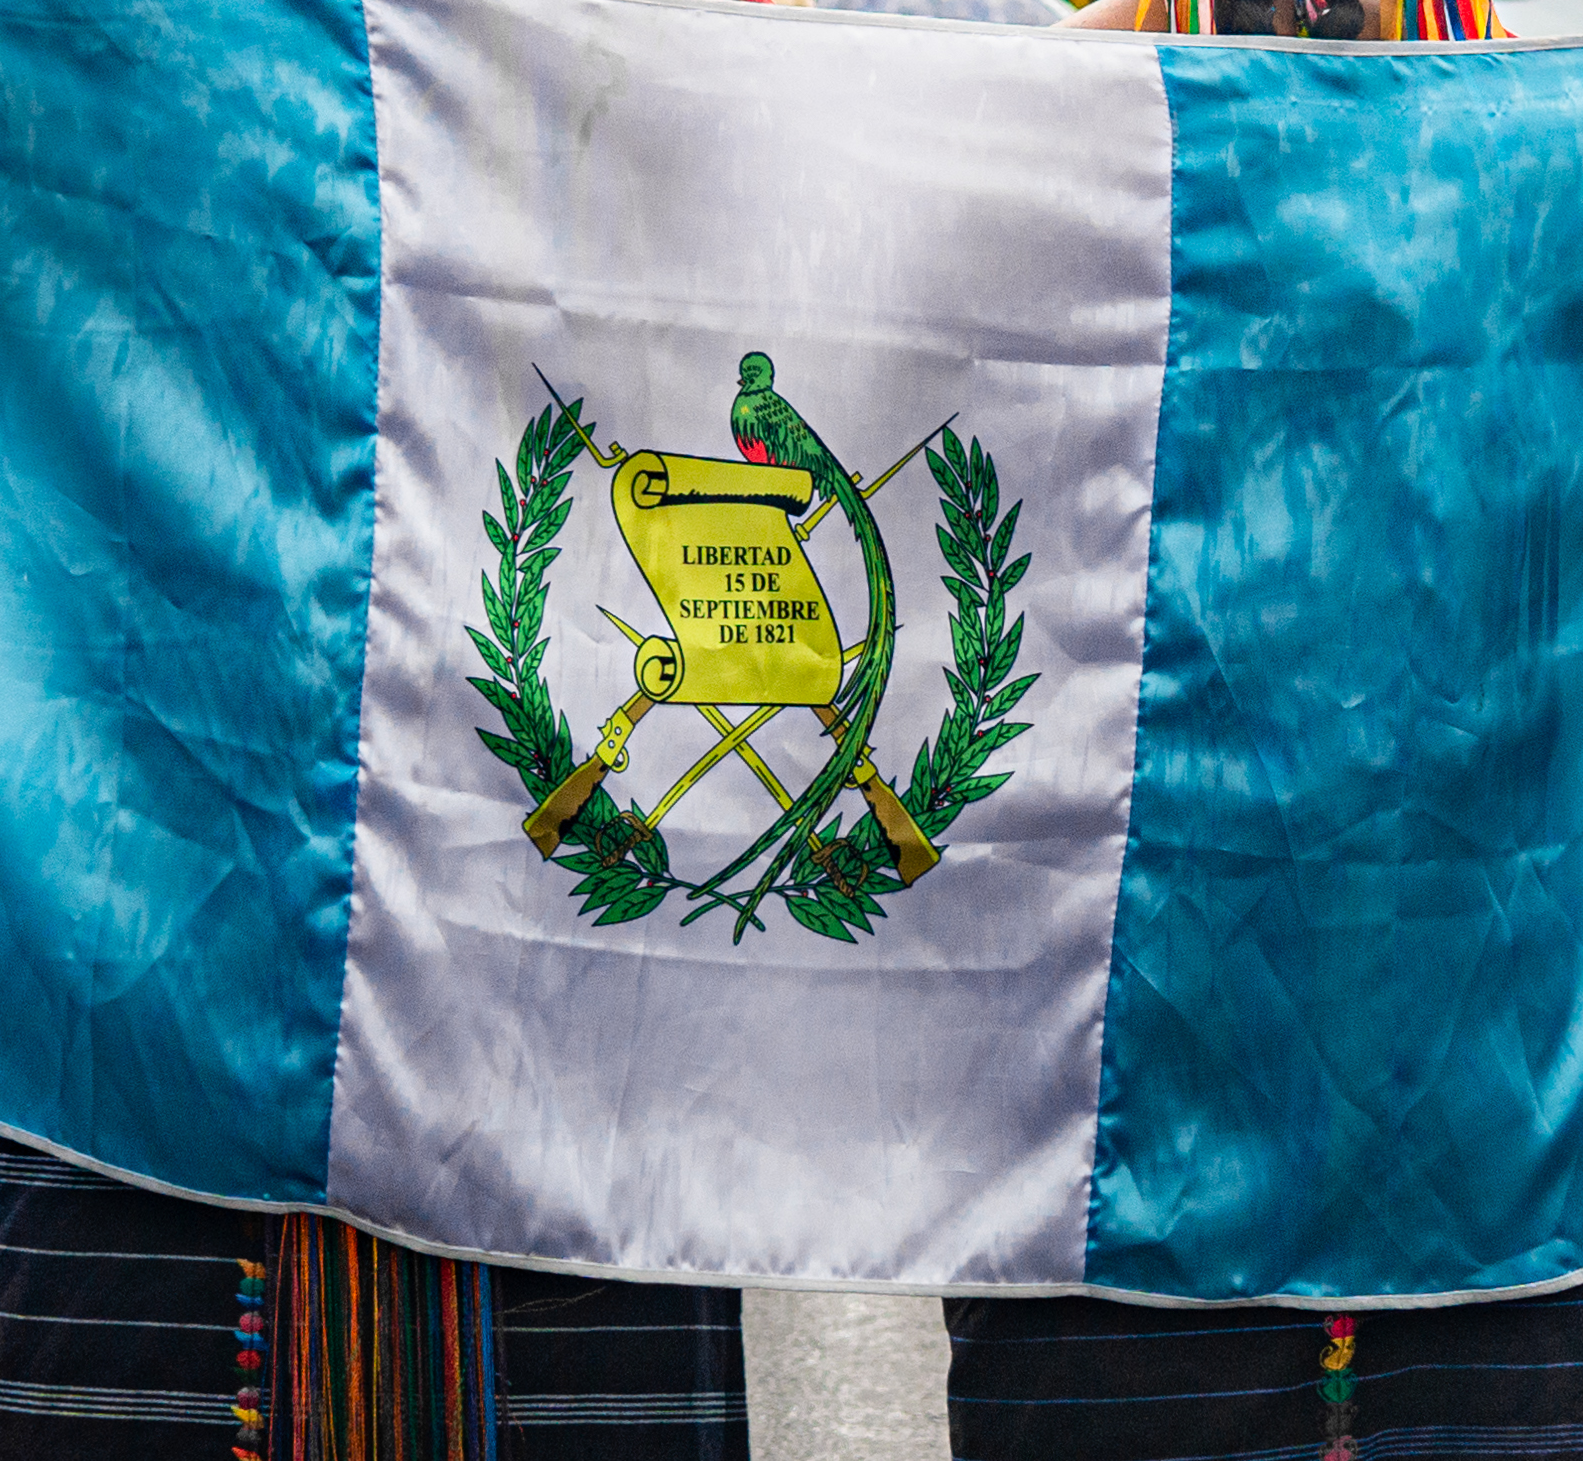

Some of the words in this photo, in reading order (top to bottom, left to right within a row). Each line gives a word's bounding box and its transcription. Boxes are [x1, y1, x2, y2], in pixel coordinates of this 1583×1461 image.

[682, 544, 792, 567] LIBERTAD
[724, 572, 745, 594] 15
[751, 572, 781, 594] DE
[679, 598, 820, 621] SEPTIEMBRE
[719, 623, 749, 644] DE
[755, 623, 796, 644] 1821
